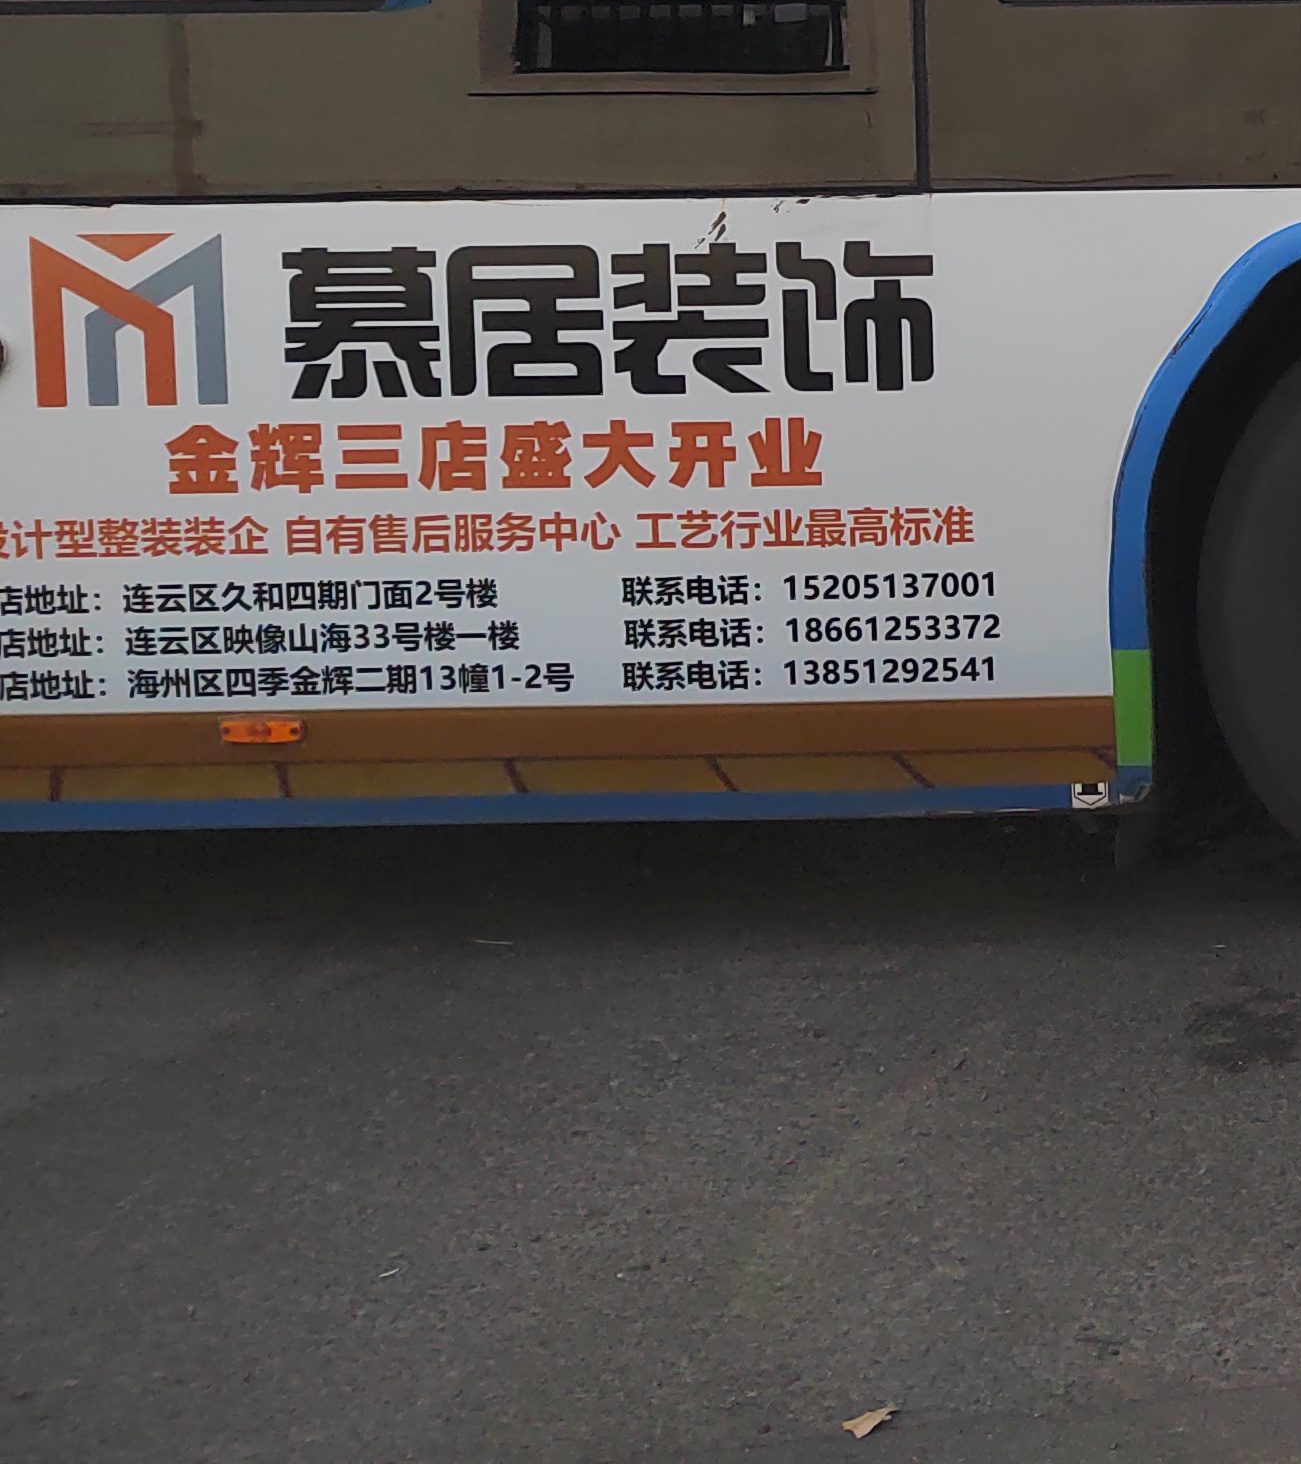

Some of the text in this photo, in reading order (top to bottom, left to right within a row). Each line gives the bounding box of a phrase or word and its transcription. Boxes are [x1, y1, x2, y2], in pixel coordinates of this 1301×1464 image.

[282, 242, 935, 399] 慕居装饰
[165, 418, 822, 494] 金辉三店盛大开业
[0, 505, 975, 561] 计型整装装企 自有售后服务中心 工艺行业最高标准
